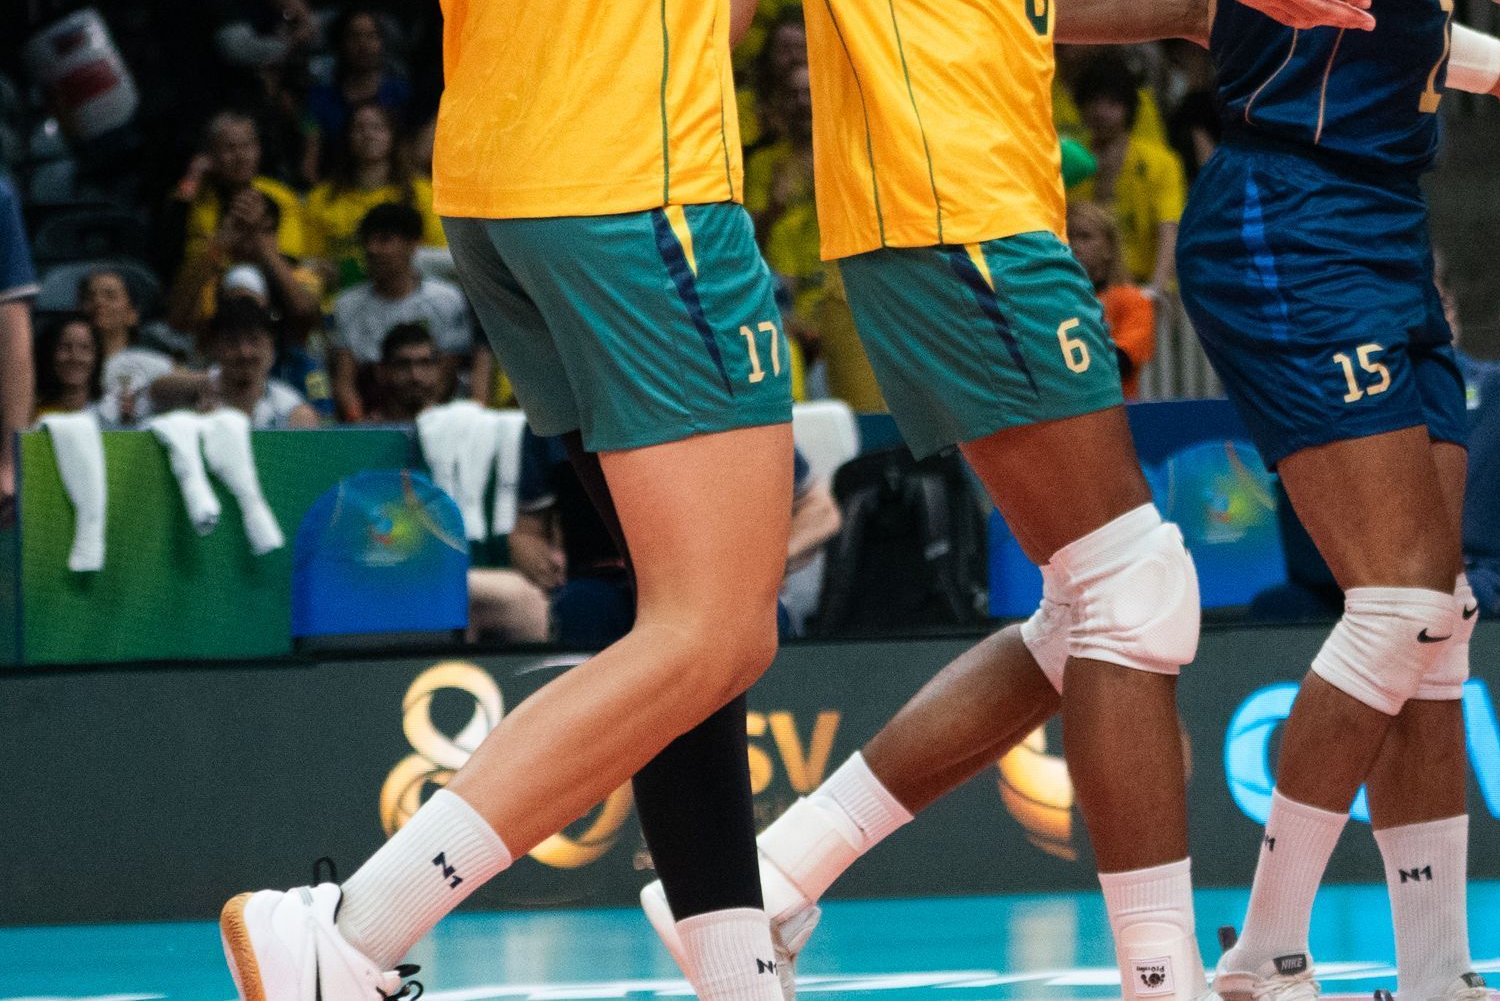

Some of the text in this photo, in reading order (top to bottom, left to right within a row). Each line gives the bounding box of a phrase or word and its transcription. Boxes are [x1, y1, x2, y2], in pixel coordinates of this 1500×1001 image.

[740, 321, 780, 383] 17
[1057, 318, 1090, 373] 6
[1333, 343, 1390, 403] 15
[1398, 865, 1433, 884] N1
[1281, 958, 1303, 971] NIKE
